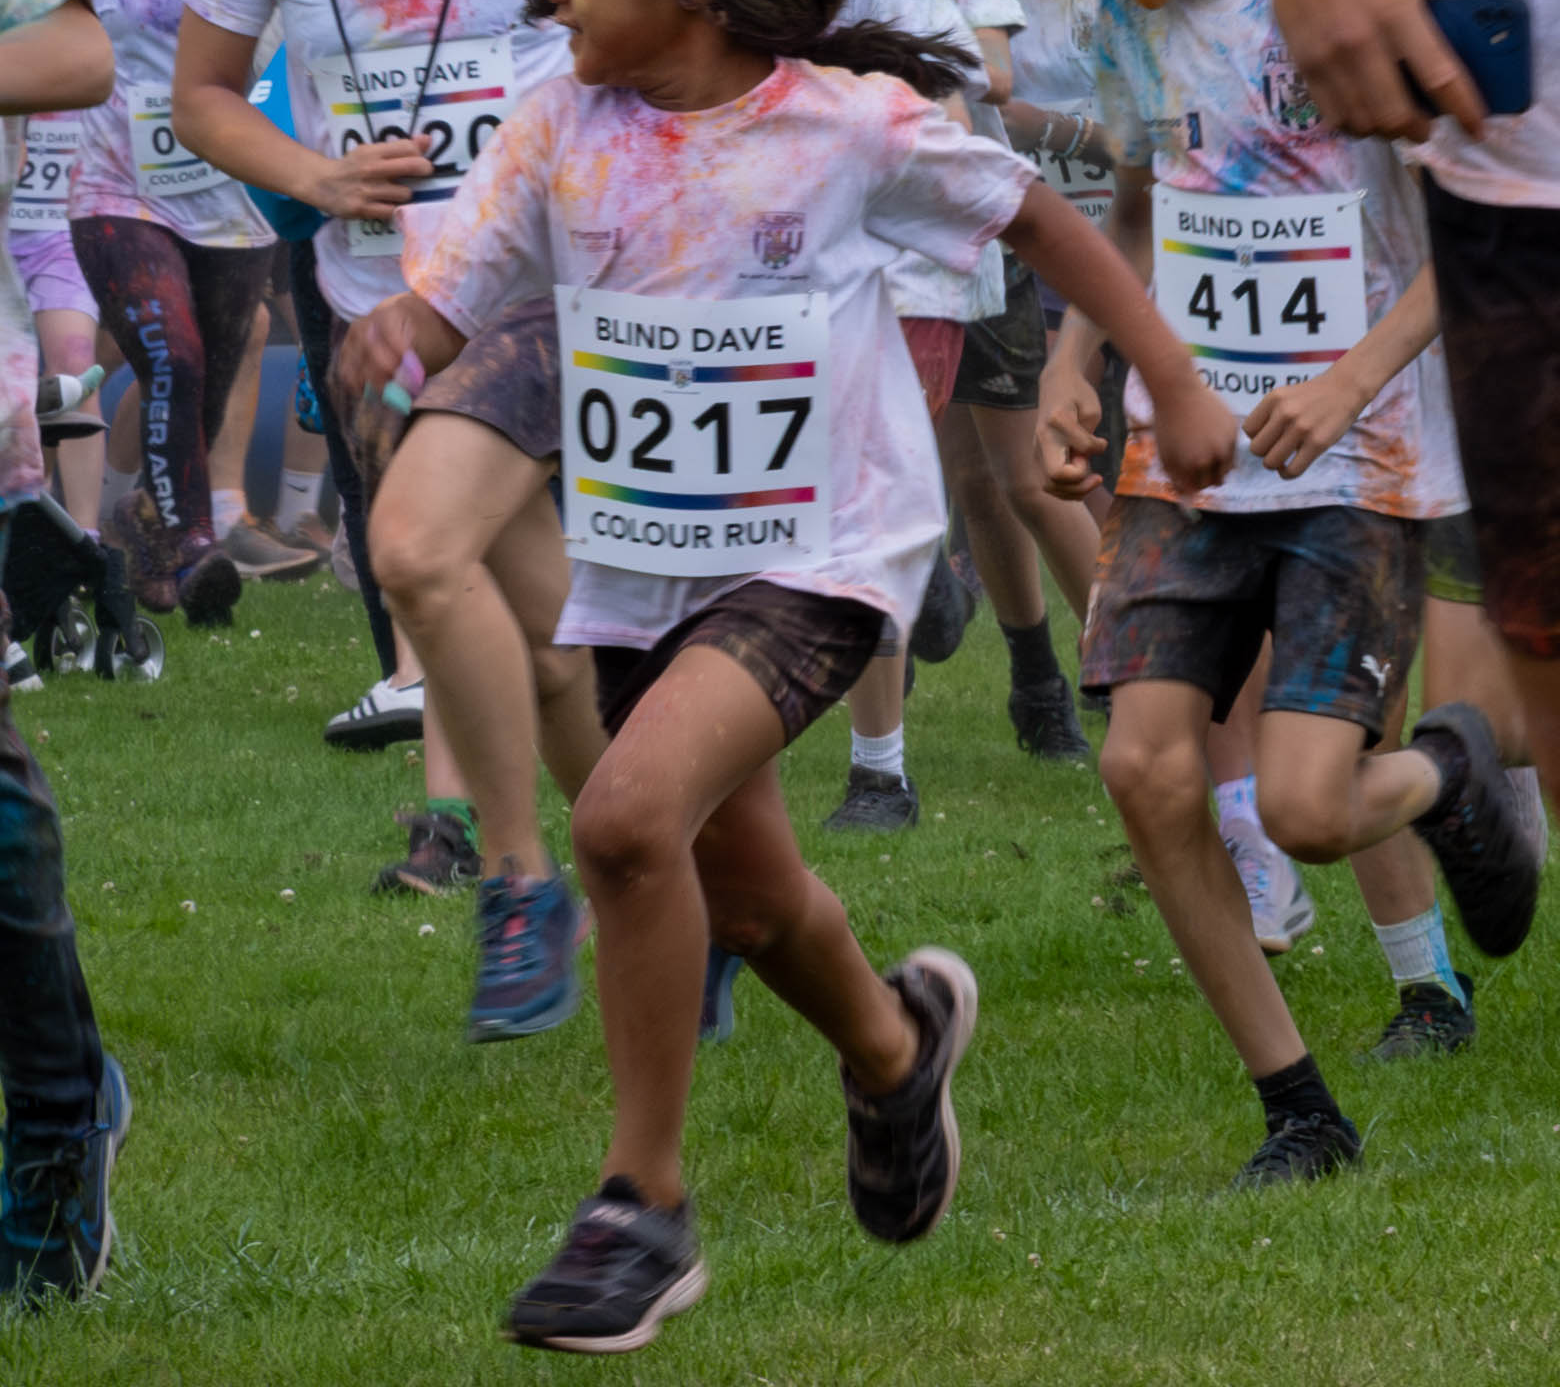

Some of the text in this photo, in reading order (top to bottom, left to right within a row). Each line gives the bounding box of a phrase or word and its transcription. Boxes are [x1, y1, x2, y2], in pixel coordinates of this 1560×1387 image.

[414, 60, 481, 86] DAVE
[150, 167, 208, 186] COLOUR
[1179, 211, 1325, 239] BLIND DAVE
[1188, 272, 1326, 336] 414
[596, 316, 785, 352] BLIND DAVE
[578, 387, 812, 475] 0217
[590, 511, 796, 549] COLOUR RUN
